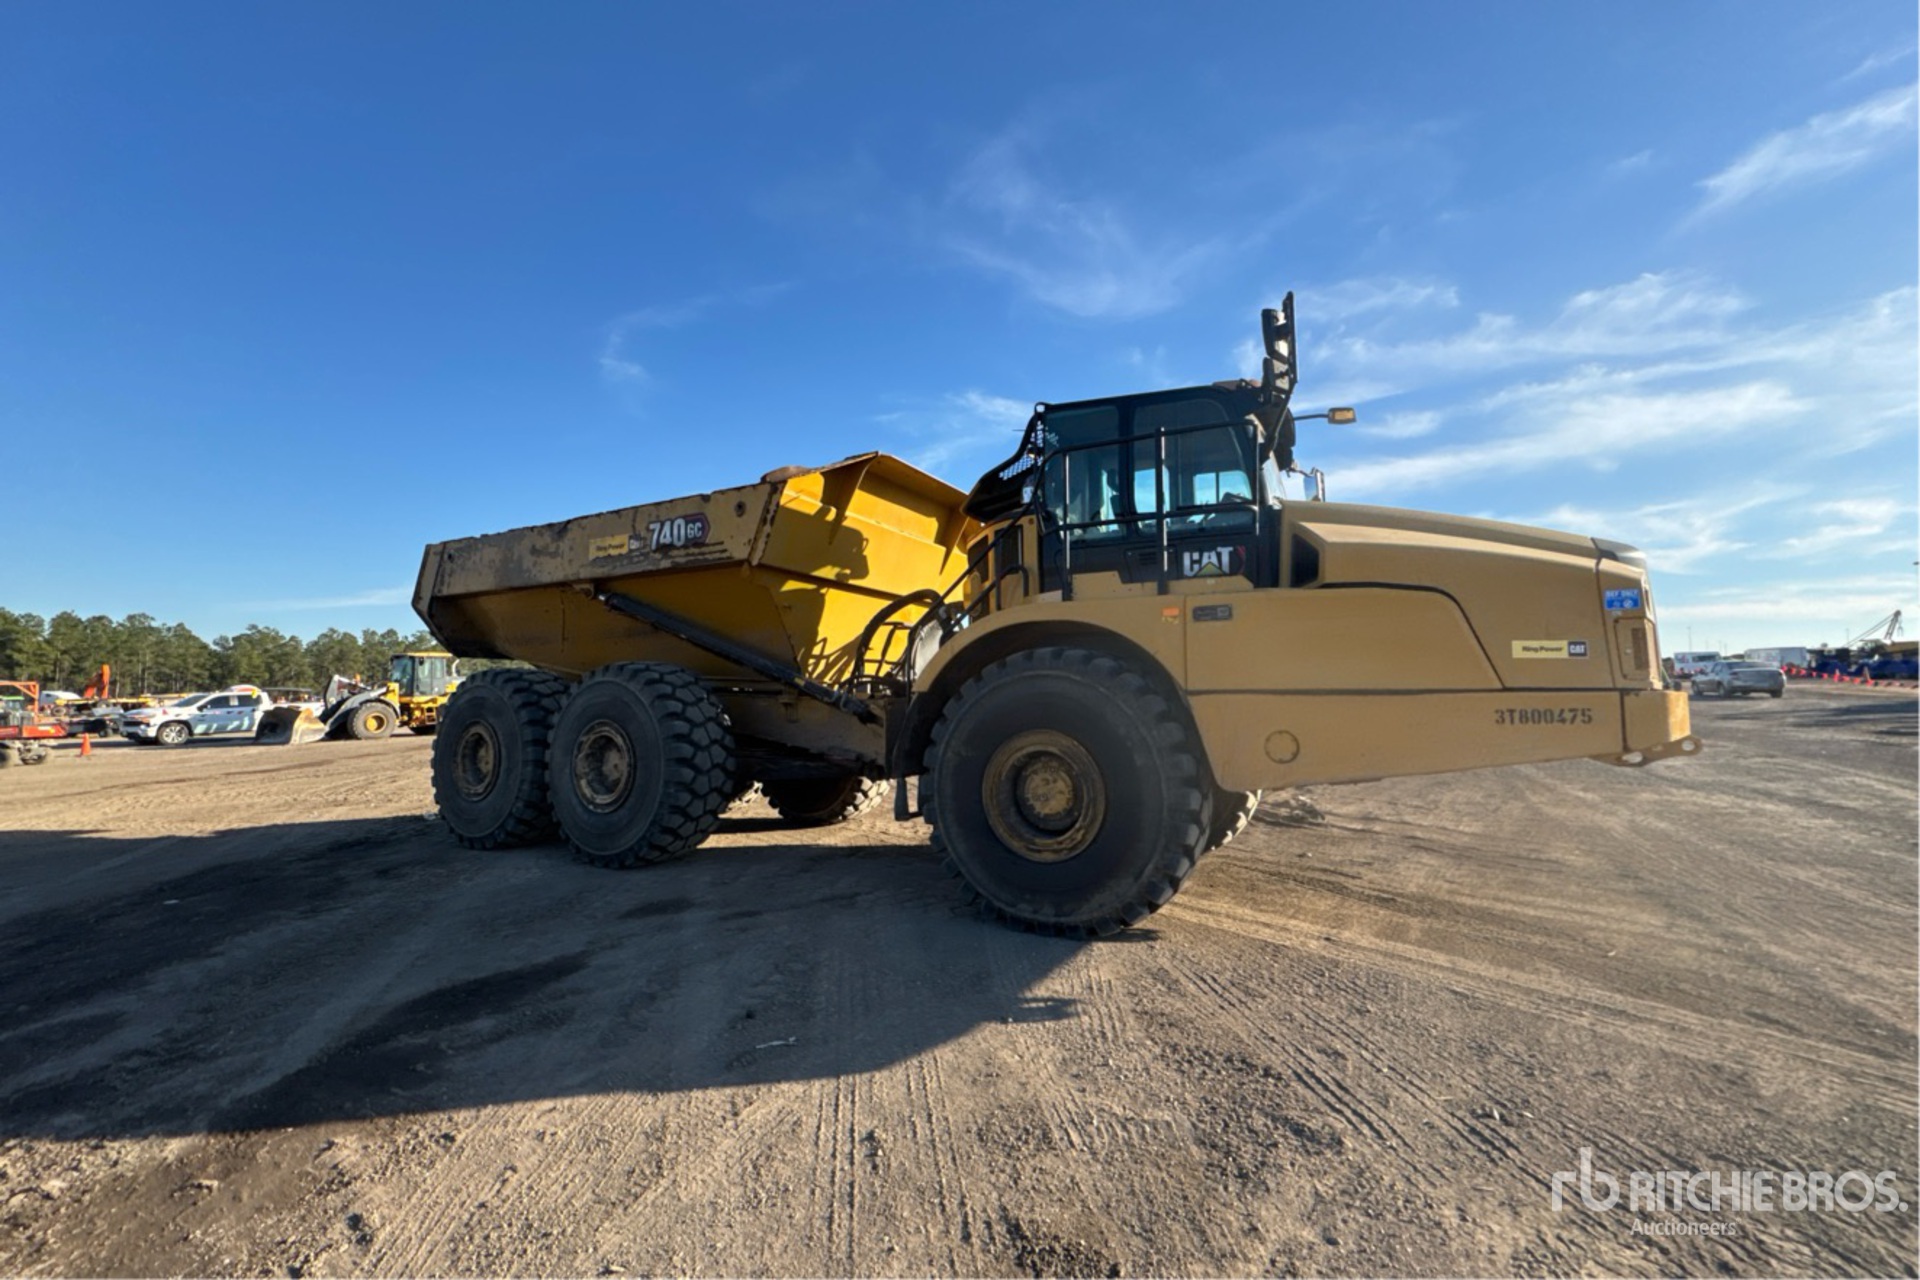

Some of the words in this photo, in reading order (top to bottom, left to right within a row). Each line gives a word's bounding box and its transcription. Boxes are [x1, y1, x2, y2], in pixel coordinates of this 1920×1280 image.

[648, 518, 686, 551] 740
[687, 522, 702, 538] GC
[1183, 546, 1234, 576] CAT
[1569, 645, 1585, 653] CAT
[1494, 708, 1593, 725] 3T800475
